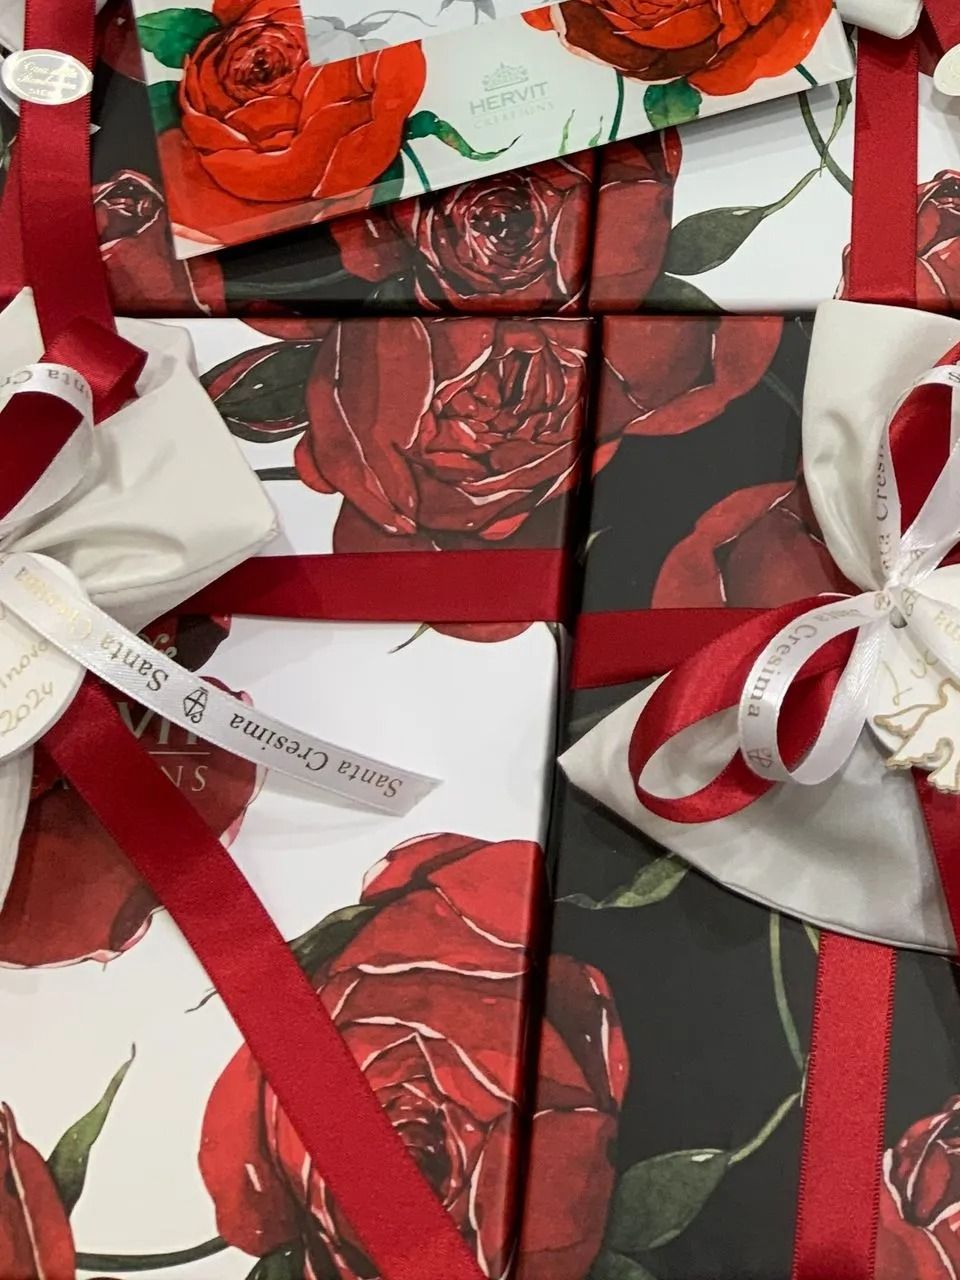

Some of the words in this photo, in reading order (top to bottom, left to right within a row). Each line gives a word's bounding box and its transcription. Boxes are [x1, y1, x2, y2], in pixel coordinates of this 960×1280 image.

[468, 80, 549, 115] HERVIT
[47, 368, 90, 400] nta
[100, 631, 170, 693] Santa
[746, 623, 819, 718] Cresima
[229, 712, 330, 772] Cresima
[337, 759, 404, 799] Santa
